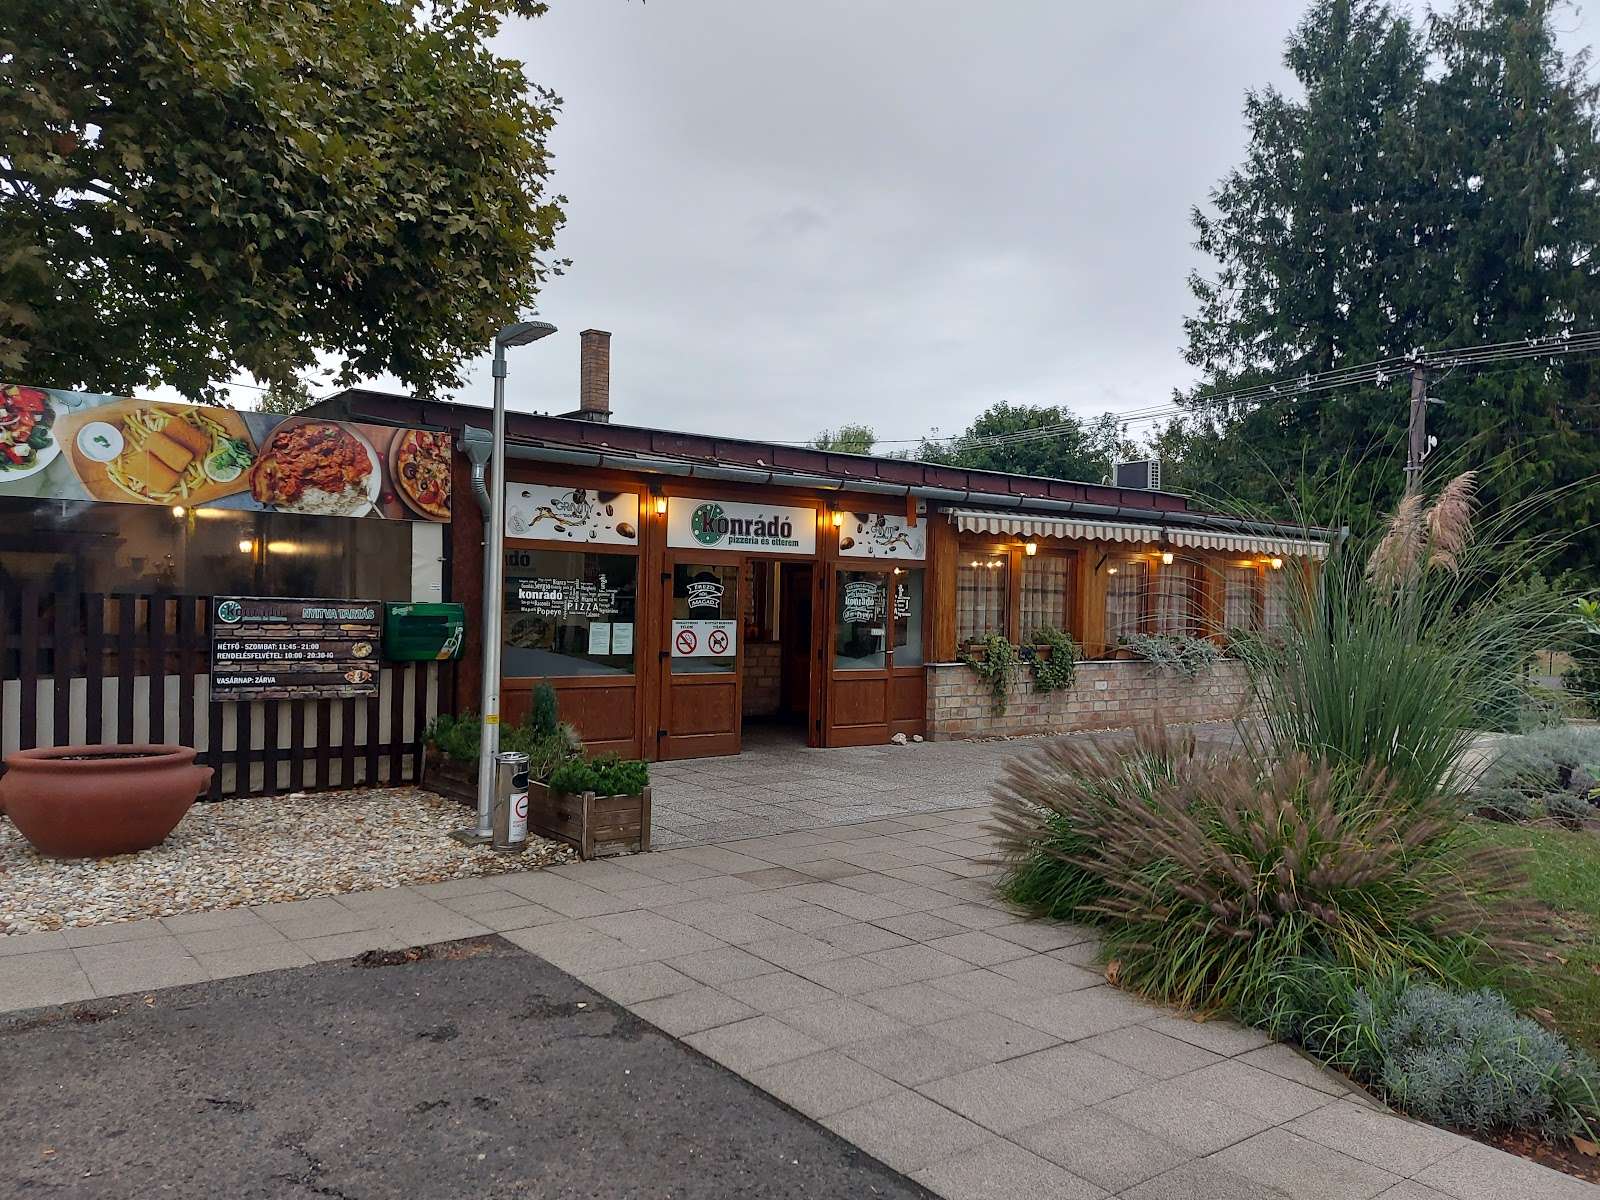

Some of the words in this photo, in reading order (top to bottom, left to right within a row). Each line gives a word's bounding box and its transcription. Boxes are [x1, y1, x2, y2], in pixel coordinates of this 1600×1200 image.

[702, 510, 793, 539] konrádó
[518, 588, 563, 600] konrádó
[536, 607, 562, 617] Popeye
[567, 602, 599, 611] PIZZA
[302, 608, 337, 619] NYITVA
[337, 606, 375, 620] TARTÁS
[216, 675, 255, 684] VASÁRNAP:
[255, 675, 276, 684] ZÁRVA
